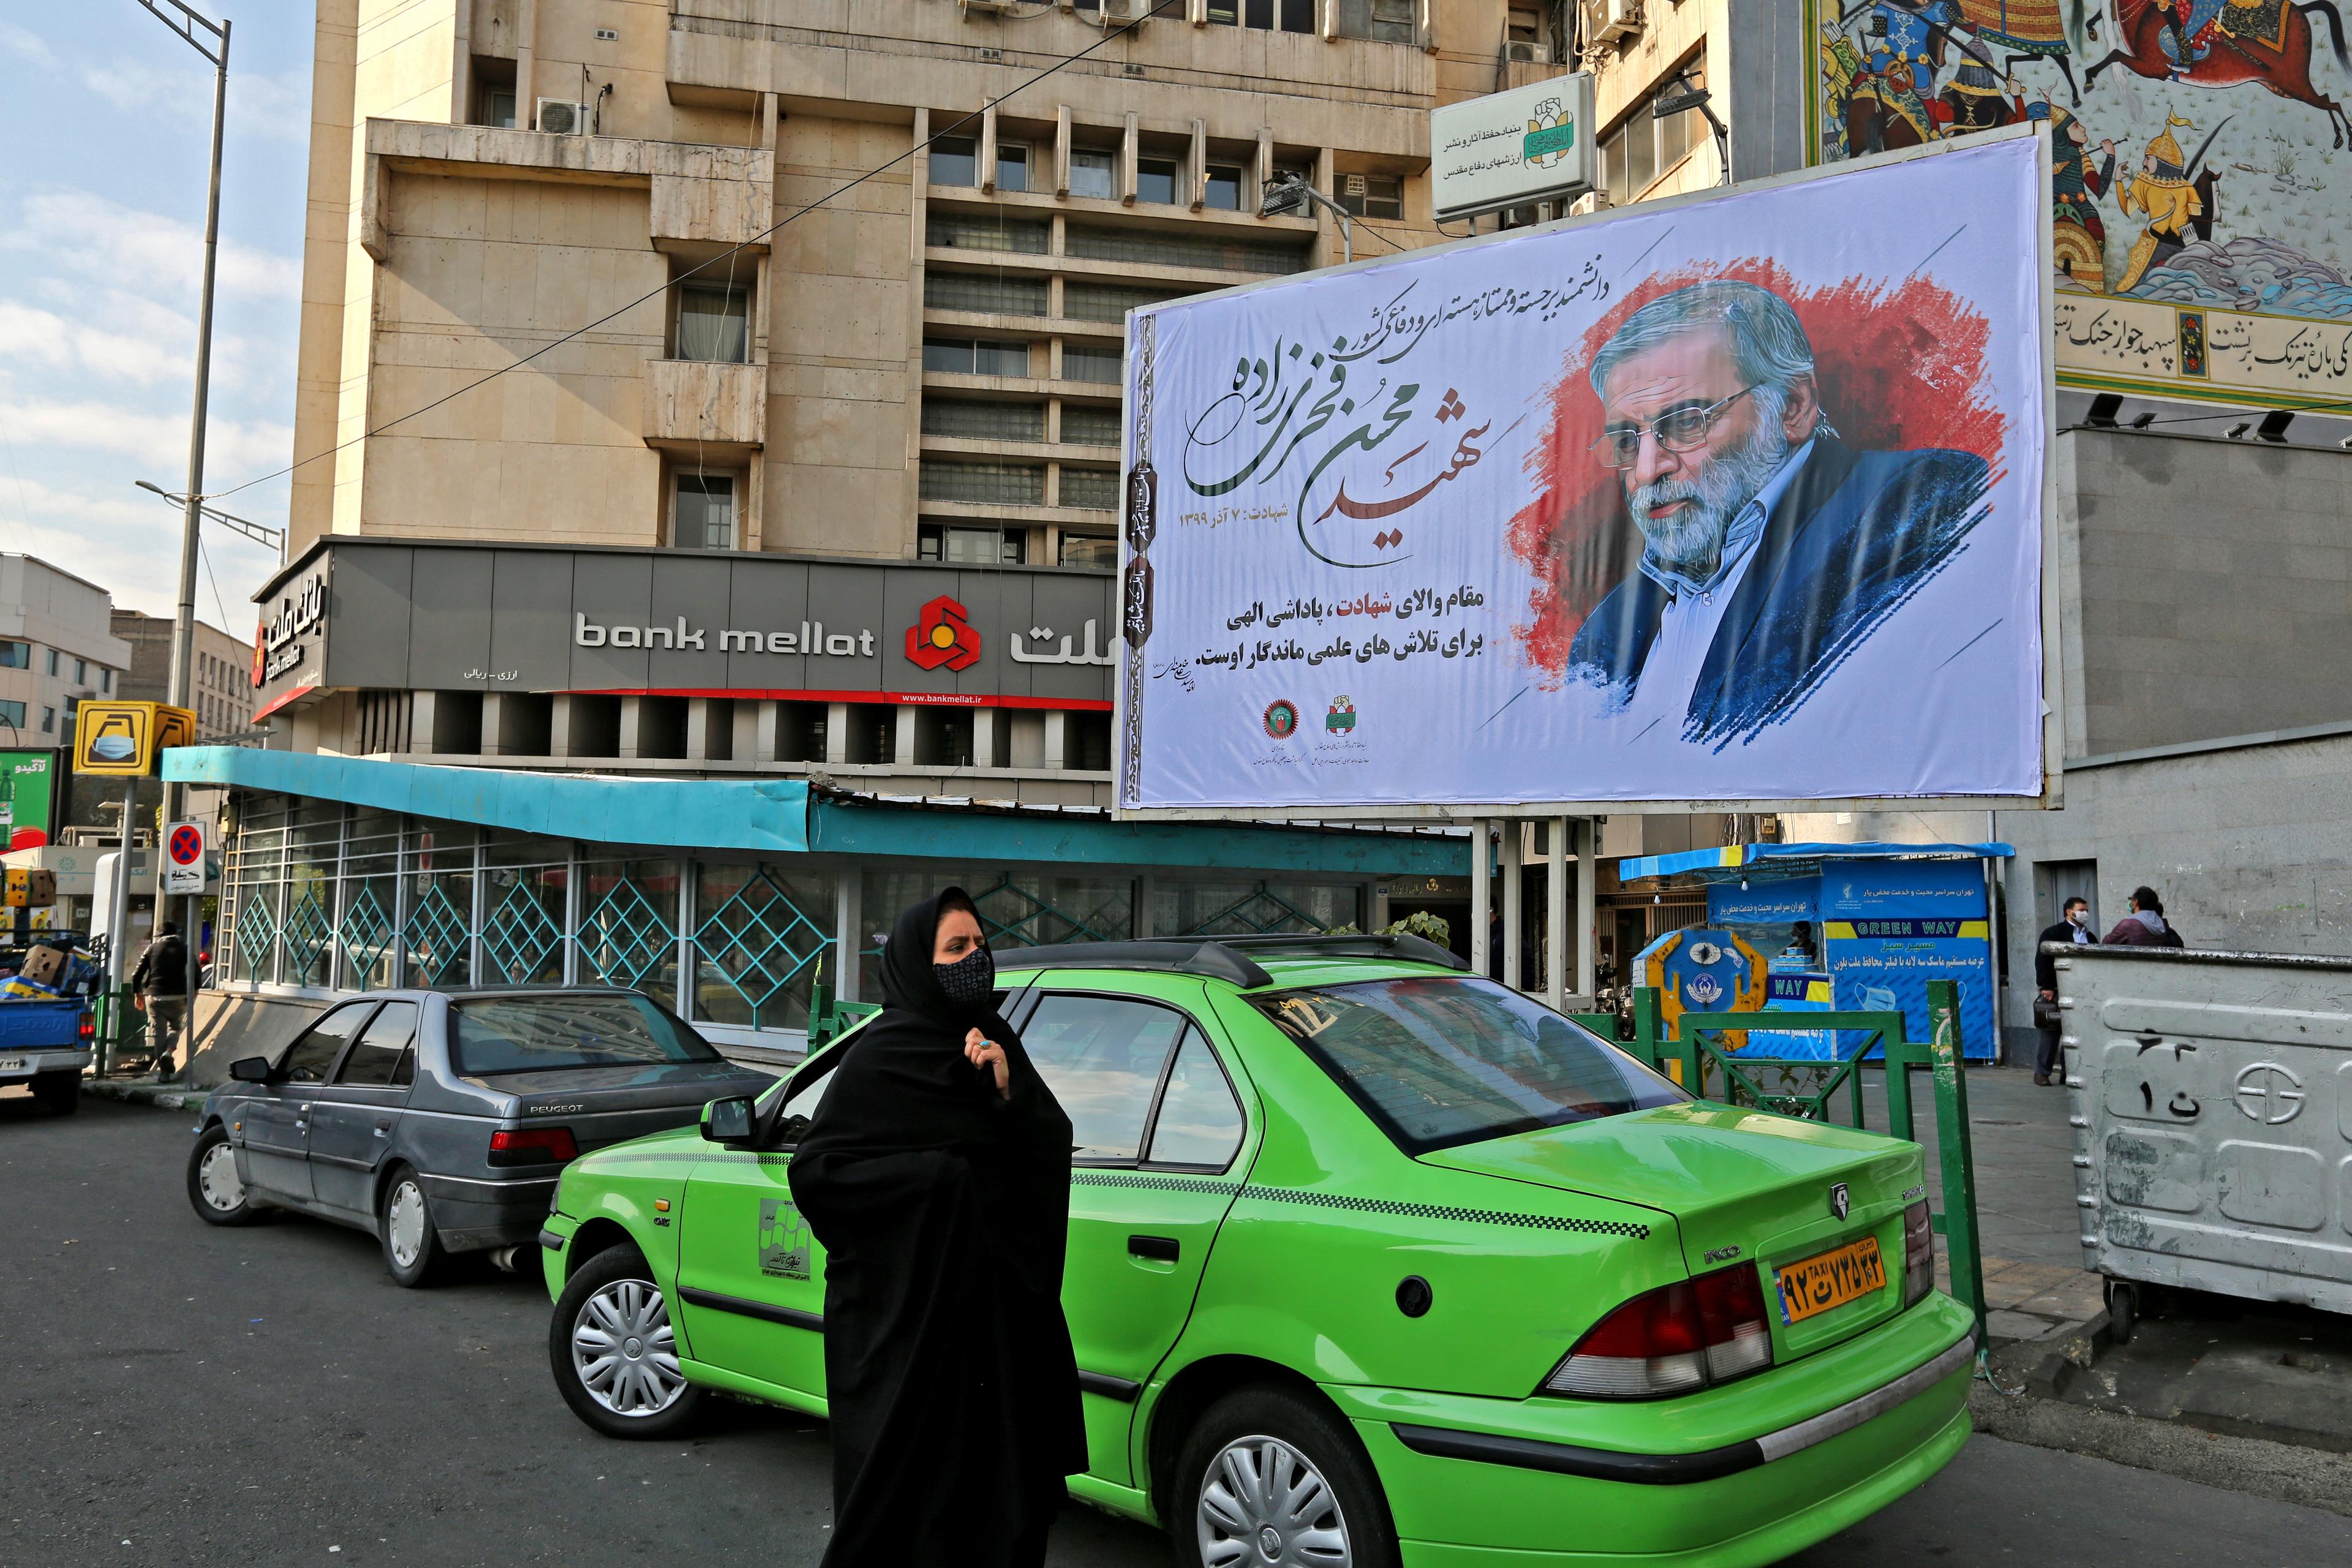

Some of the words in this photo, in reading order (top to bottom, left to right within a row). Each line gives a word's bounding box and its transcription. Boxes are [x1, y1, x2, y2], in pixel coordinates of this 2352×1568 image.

[1467, 130, 1482, 147] آثار
[1482, 129, 1501, 140] حفظ
[1501, 124, 1521, 137] بنیاد
[1443, 138, 1461, 152] نشر
[1461, 138, 1466, 148] و
[1444, 165, 1468, 179] مقدس
[1469, 161, 1485, 175] دفاع
[1555, 254, 1610, 308] دانشمند
[1474, 287, 1514, 321] ممتاز
[1507, 295, 1516, 314] و
[1513, 288, 1559, 322] برجسته
[1351, 278, 1419, 351] کشور
[1297, 378, 1420, 568] محسن
[1313, 388, 1491, 549] شهید
[1179, 511, 1208, 527] ۱۳۹۹
[1210, 507, 1230, 528] آذر
[1231, 508, 1240, 521] ۷
[295, 573, 322, 636] بانک
[1336, 592, 1392, 619] شهادت
[1396, 587, 1442, 619] والای
[1446, 584, 1484, 616] مقام
[1227, 601, 1263, 630] الهی
[1266, 597, 1323, 628] پاداشی
[268, 598, 292, 652] ملت
[575, 612, 706, 650] bank
[720, 620, 875, 657] mellat
[1441, 627, 1483, 658] برای
[1246, 638, 1304, 669] ماندگار
[1307, 636, 1352, 666] علمی
[1355, 633, 1390, 663] های
[1393, 629, 1439, 661] تلاش
[266, 655, 281, 680] bank
[281, 644, 300, 671] mellat
[1196, 641, 1245, 671] اوست.
[464, 668, 487, 680] ریالی
[497, 669, 518, 680] ارزی
[902, 692, 982, 705] www.bankmellat.ir
[1773, 903, 1790, 913] سراسر
[1791, 902, 1806, 912] تهران
[1858, 921, 1912, 935] GREEN
[1921, 921, 1956, 935] WAY
[1881, 940, 1904, 952] سبز
[1905, 941, 1936, 952] مسیر
[1862, 955, 1883, 967] محافظ
[1884, 955, 1898, 970] فیلتر
[1906, 955, 1916, 970] لایه
[1926, 955, 1945, 967] ماسک
[1946, 956, 1967, 969] مستقیم
[1968, 956, 1985, 969] عرضه
[1775, 979, 1802, 995] WAY
[530, 1104, 584, 1114] PEUGEOT
[1808, 1261, 1829, 1280] TAXI
[1784, 1269, 1809, 1312] ۹۲
